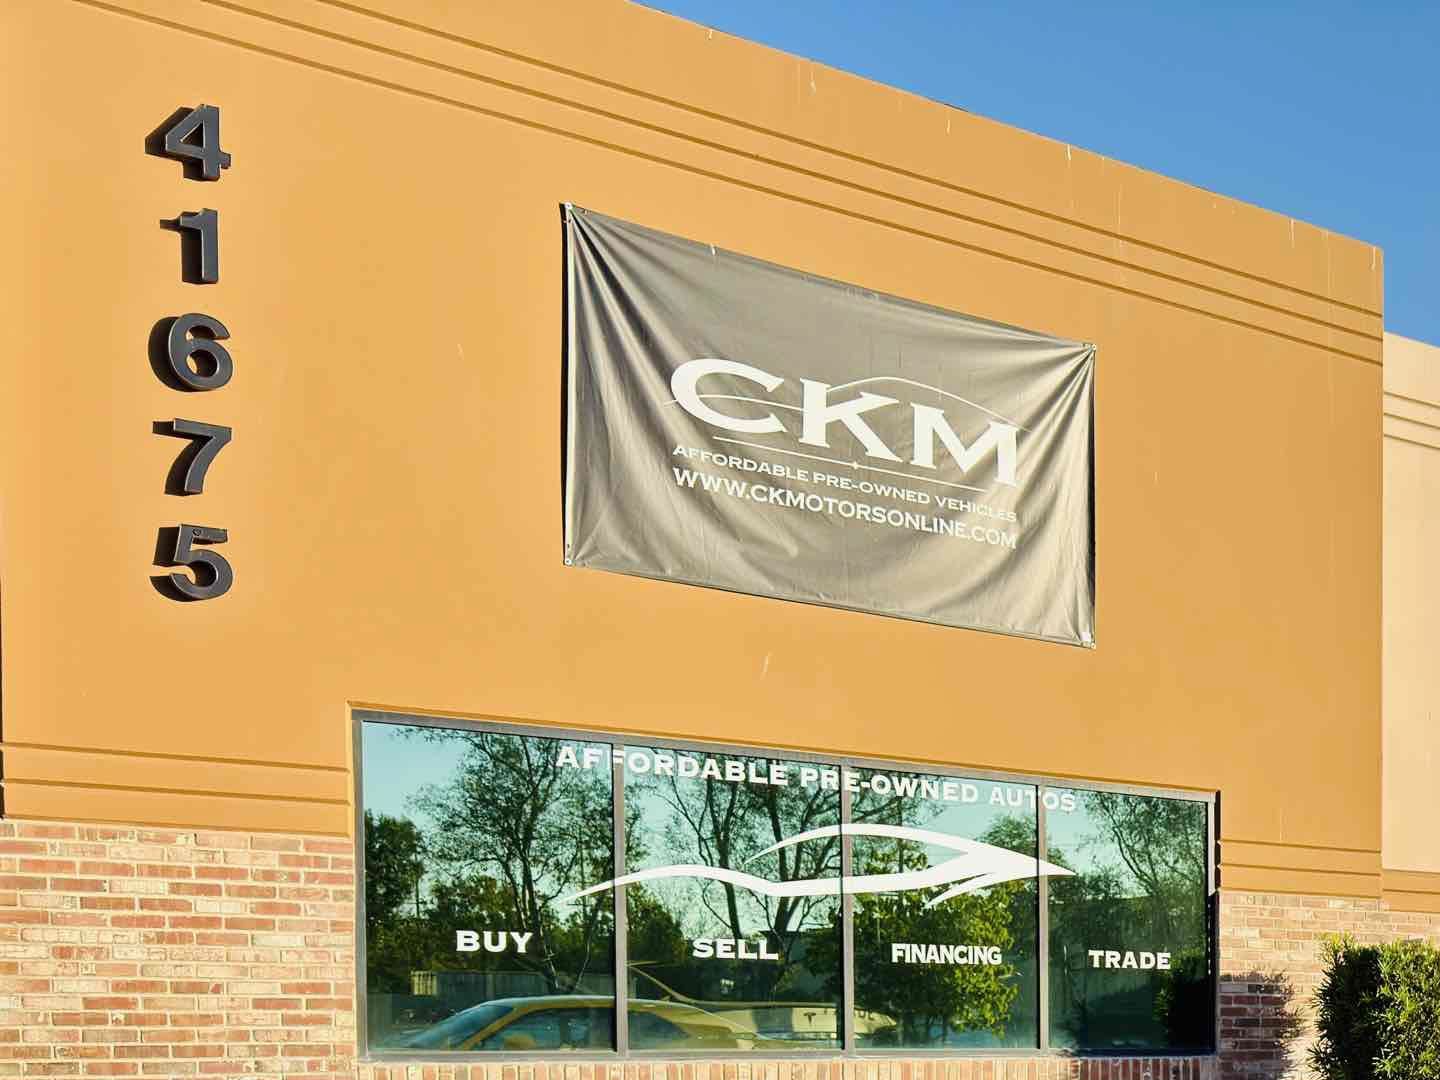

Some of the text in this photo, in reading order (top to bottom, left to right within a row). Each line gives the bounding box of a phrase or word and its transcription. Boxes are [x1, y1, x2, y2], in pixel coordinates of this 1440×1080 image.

[145, 104, 233, 602] 41675
[671, 358, 1017, 486] CKM
[672, 467, 1017, 549] WWW.CKMOTORSONLINE.COM
[673, 445, 1017, 523] AFFORDABLE PRE-OWNED VEHICLES
[555, 746, 1076, 812] AFFORDABLE PRE-OWNED AUTOS
[456, 930, 533, 953] BUY
[692, 938, 778, 960] SELL
[891, 943, 1002, 965] FINANCING
[1088, 949, 1171, 970] TRADE
